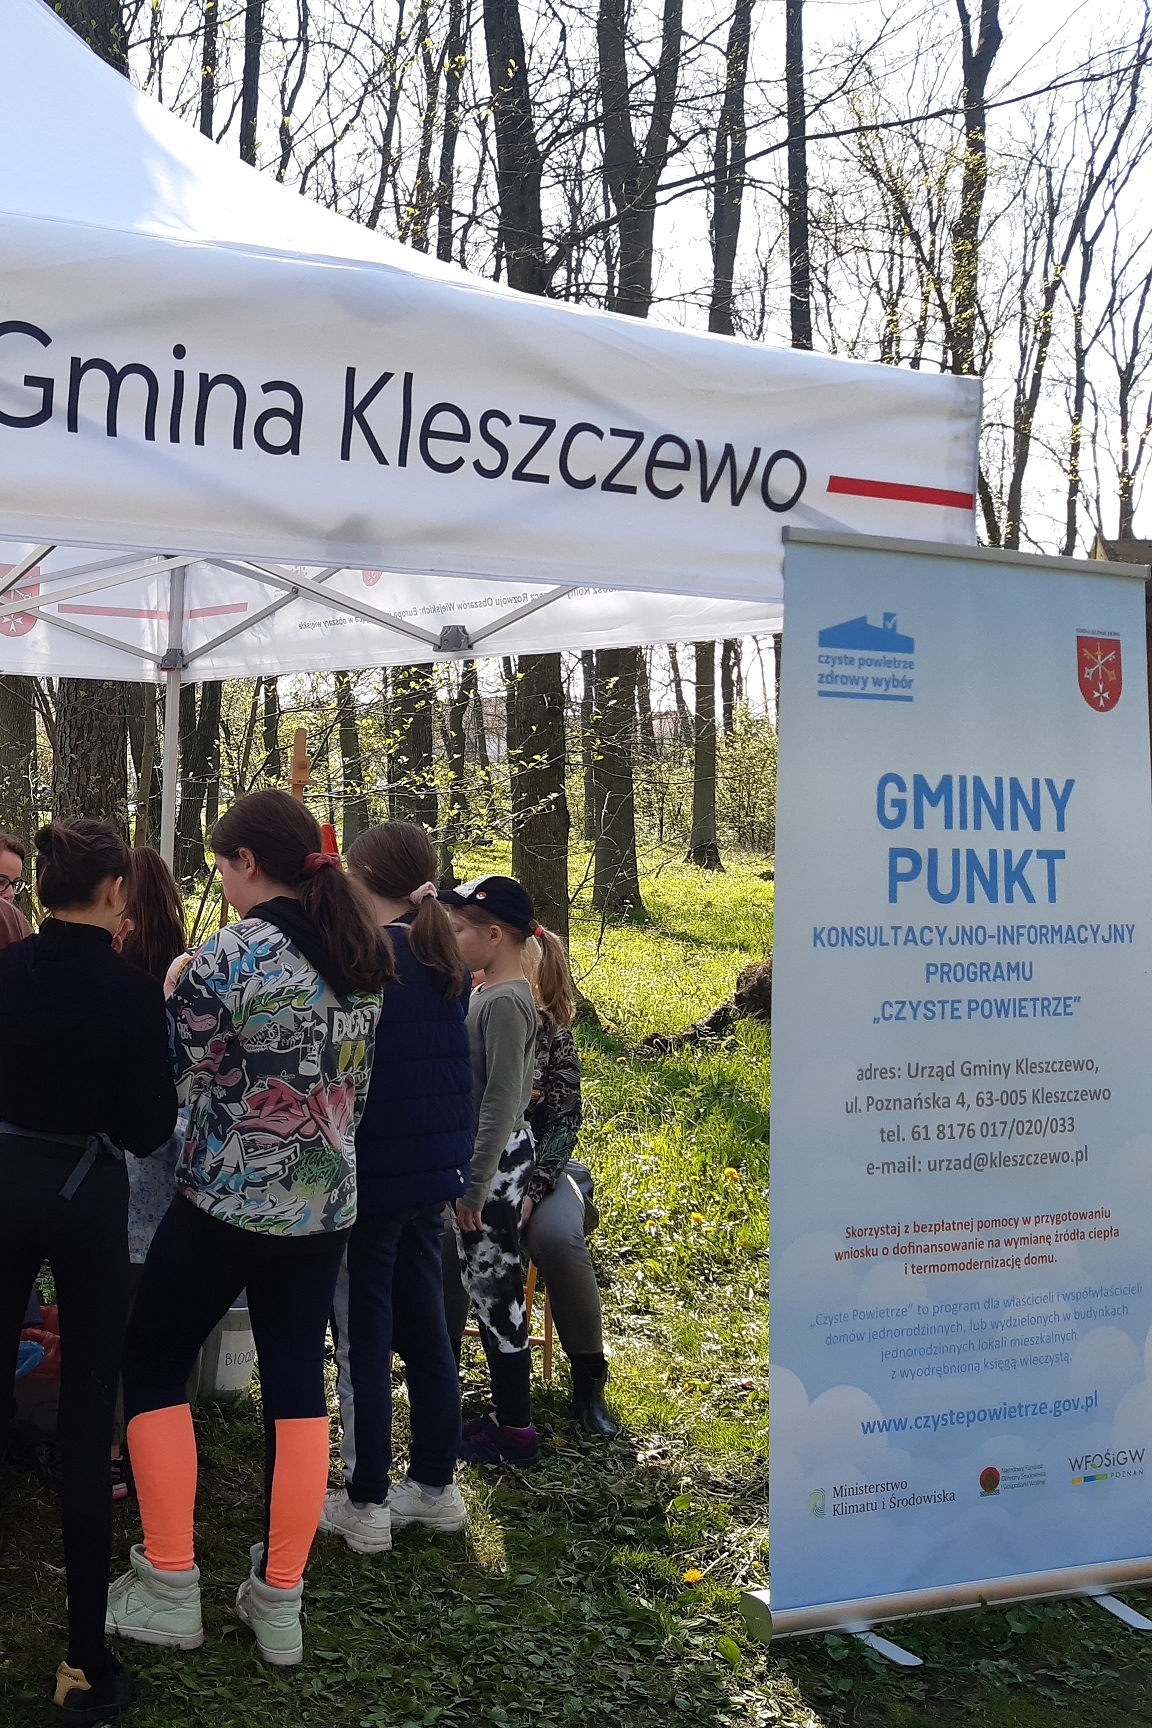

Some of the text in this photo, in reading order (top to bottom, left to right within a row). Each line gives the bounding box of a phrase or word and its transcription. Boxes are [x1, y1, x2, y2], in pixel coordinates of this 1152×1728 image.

[340, 366, 807, 513] Kleszczewo
[818, 654, 914, 670] czyste powietrze
[817, 671, 914, 690] zdrowy wybór
[877, 772, 1076, 832] GMINNY
[889, 848, 1066, 904] PUNKT
[813, 924, 1135, 947] KONSULTACYJNO-INFORMACYJNY
[926, 961, 1033, 983] PROGRAMU
[856, 1056, 1099, 1082] adres: Urząd Gminy Kleszczewo,
[845, 1087, 1112, 1114] ul. Poznańska 4, 63-005 Kleszczewo
[880, 1116, 1075, 1143] tel. 61 8176 017/020/033
[866, 1145, 1089, 1175] e-mail: urzad@kleszczewo.pl
[845, 1207, 1111, 1240] Skorzystaj z bezpłatnej pomocy w przygotowaniu
[834, 1226, 1120, 1261] wniosku o dofinansowanie na wymianę źródła ciepła
[911, 1255, 1021, 1276] termomodernizację
[1024, 1252, 1057, 1266] domu.
[917, 1304, 929, 1316] to
[932, 1300, 980, 1317] program
[983, 1297, 1000, 1310] dla
[1003, 1292, 1054, 1309] właścicieli
[1061, 1283, 1143, 1303] współwłaścicieli
[825, 1304, 1128, 1346] domów jednorodzinnych, lub wydzielonych w budynkach
[880, 1329, 1078, 1363] jednorodzinnych lokali mieszkalnych
[891, 1369, 896, 1379] z
[900, 1360, 981, 1380] wyodrębnioną
[983, 1356, 1017, 1372] księgą
[861, 1390, 1098, 1435] www.czystepowietrze.gov.pl
[1069, 1448, 1145, 1471] WFOŚiGW
[1110, 1469, 1144, 1478] POZNAŃ
[832, 1478, 908, 1499] Ministerstwo
[832, 1489, 956, 1517] Klimatu i Środowiska
